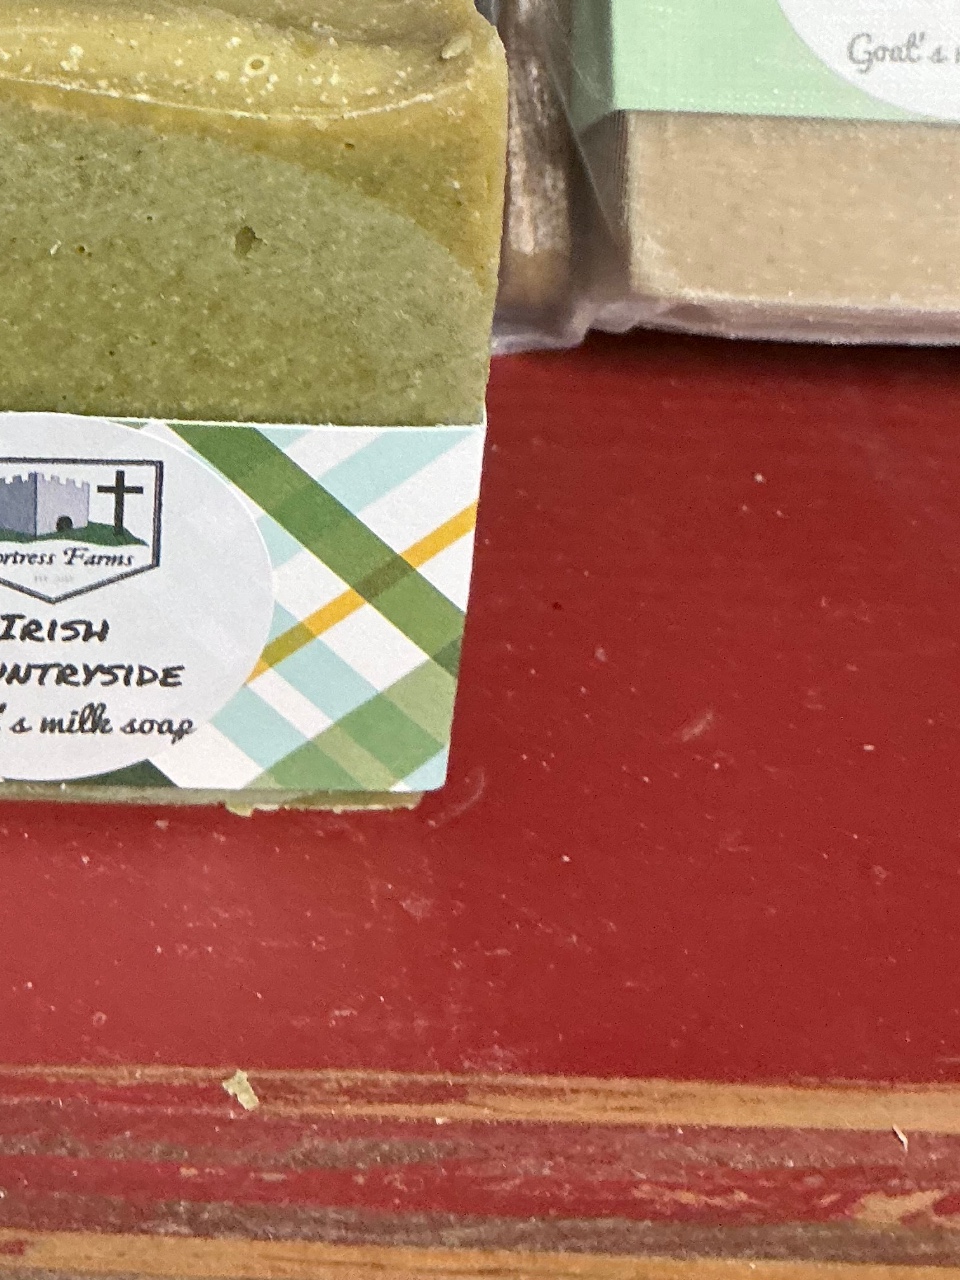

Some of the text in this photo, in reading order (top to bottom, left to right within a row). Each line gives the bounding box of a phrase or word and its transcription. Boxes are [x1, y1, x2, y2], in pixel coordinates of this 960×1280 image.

[846, 32, 947, 74] Goat's
[63, 547, 135, 567] Farms
[40, 703, 113, 735] milk
[120, 716, 196, 744] soap
